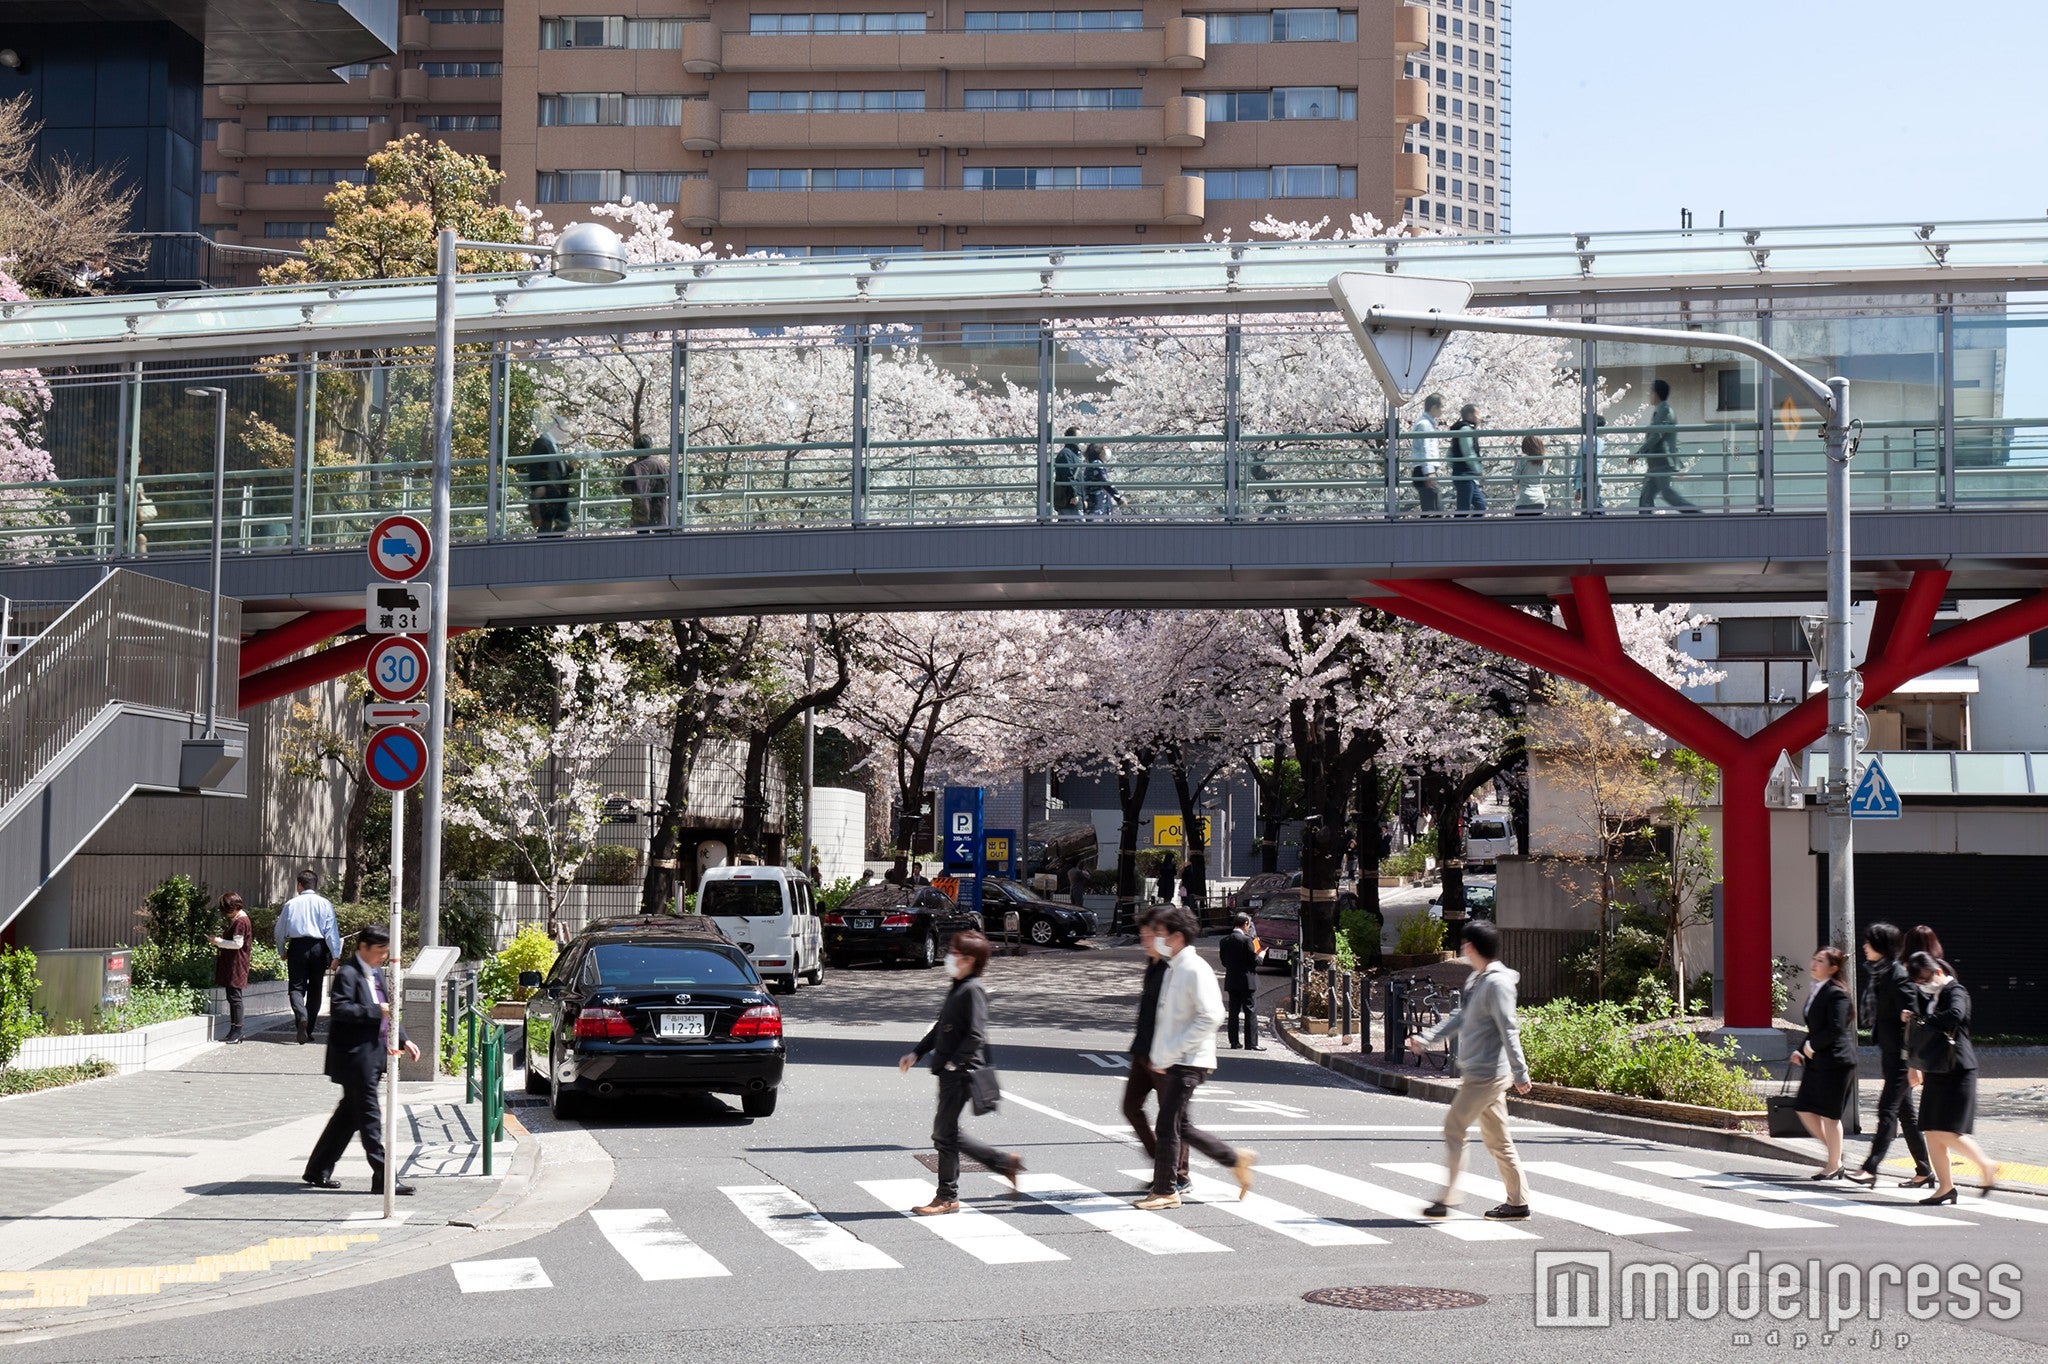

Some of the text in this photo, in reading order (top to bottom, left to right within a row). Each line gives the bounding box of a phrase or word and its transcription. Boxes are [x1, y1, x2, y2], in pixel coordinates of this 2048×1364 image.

[382, 655, 415, 683] 30
[957, 815, 969, 831] P
[988, 841, 1007, 850] 出口
[672, 1023, 702, 1034] 12-23
